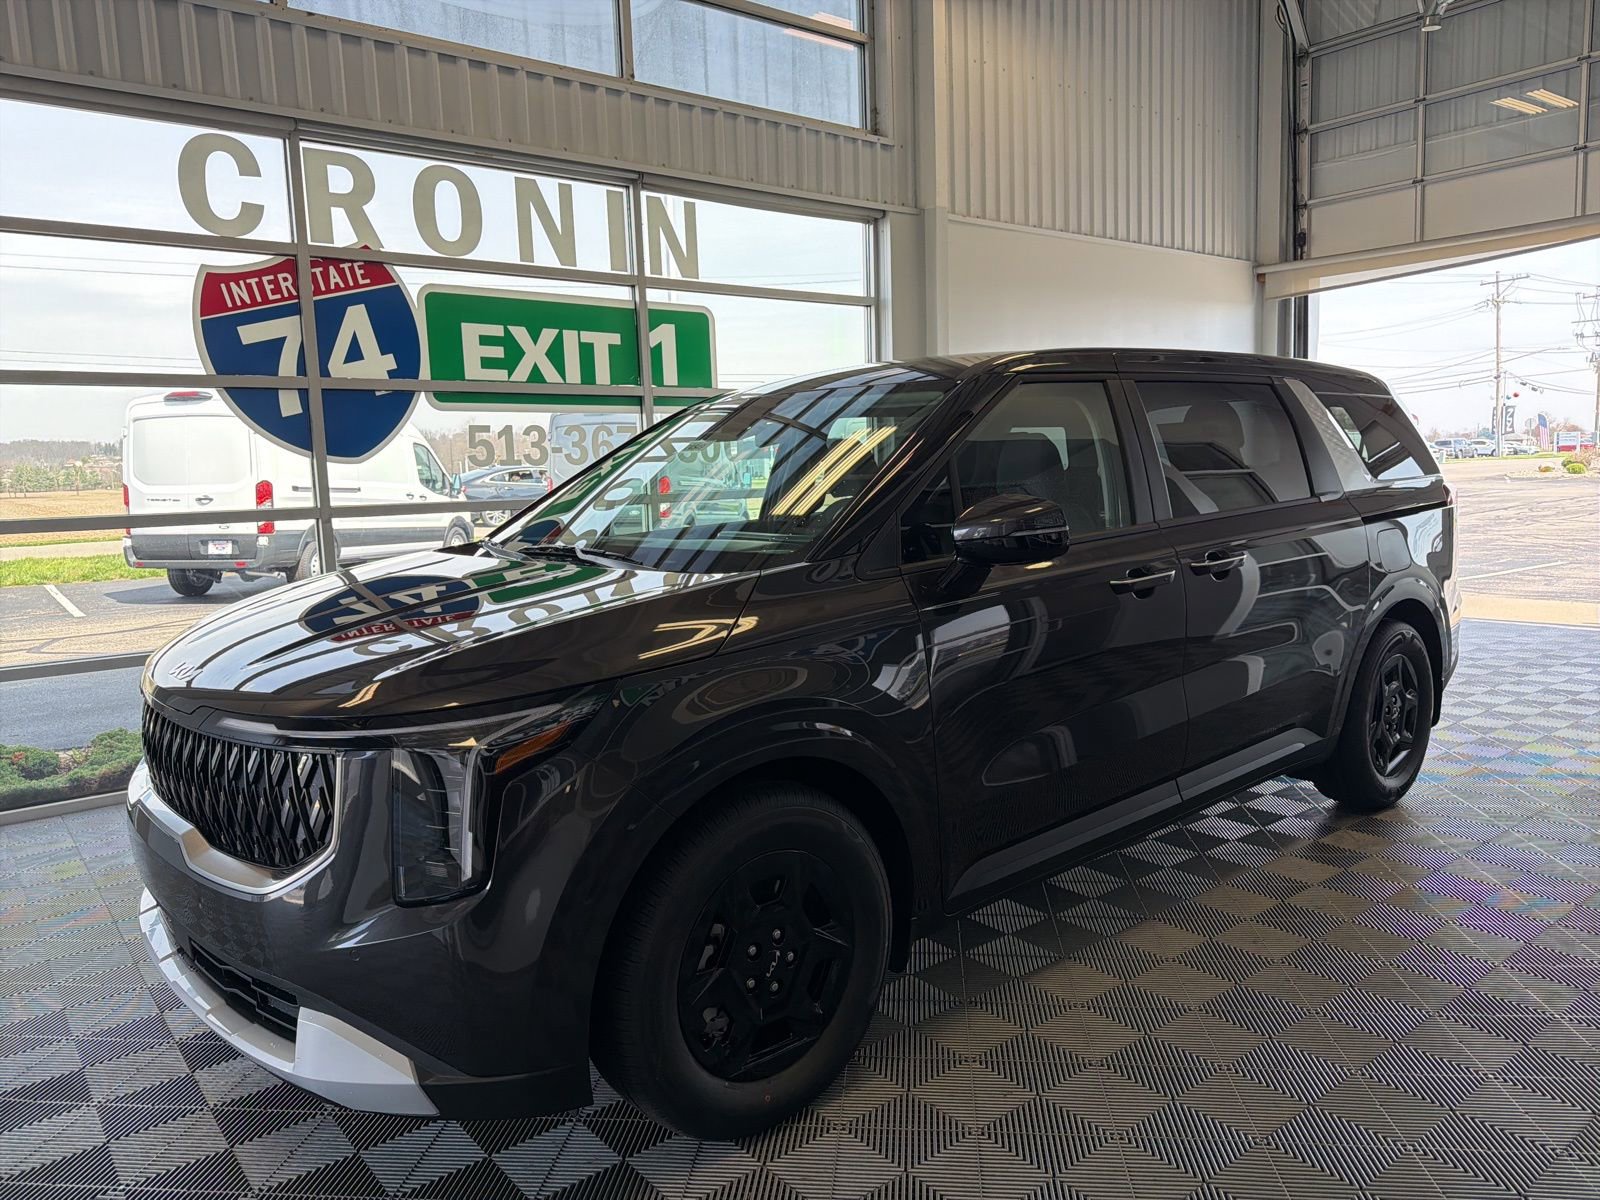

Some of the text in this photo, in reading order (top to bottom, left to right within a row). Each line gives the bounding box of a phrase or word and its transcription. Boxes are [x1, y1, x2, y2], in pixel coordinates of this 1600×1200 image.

[178, 133, 699, 279] CRONIN
[220, 261, 371, 308] INTERTATE
[236, 303, 397, 418] 74
[461, 322, 678, 386] EXIT 1
